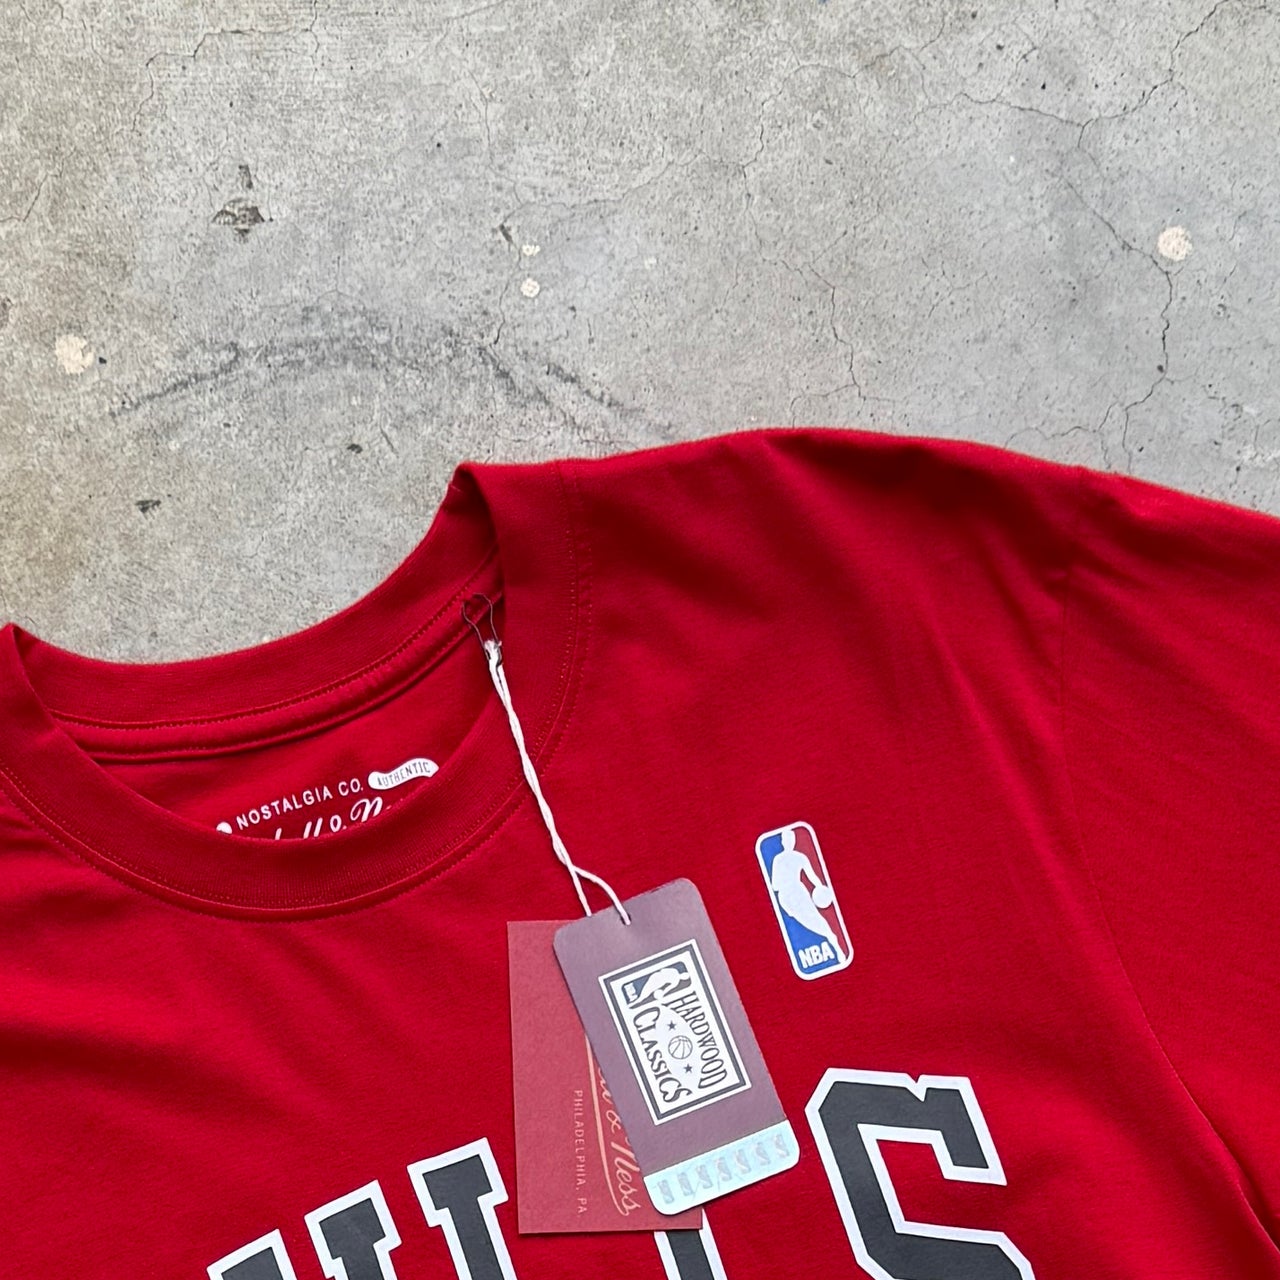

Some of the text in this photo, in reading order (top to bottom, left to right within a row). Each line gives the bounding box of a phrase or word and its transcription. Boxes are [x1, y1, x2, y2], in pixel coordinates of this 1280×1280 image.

[236, 785, 333, 830] NOSTALGIA
[338, 778, 364, 797] CO.
[377, 762, 430, 787] AUTHENTIC
[798, 941, 835, 969] NBA
[633, 1001, 694, 1104] CLASSICS
[675, 990, 728, 1090] HARDWOOD
